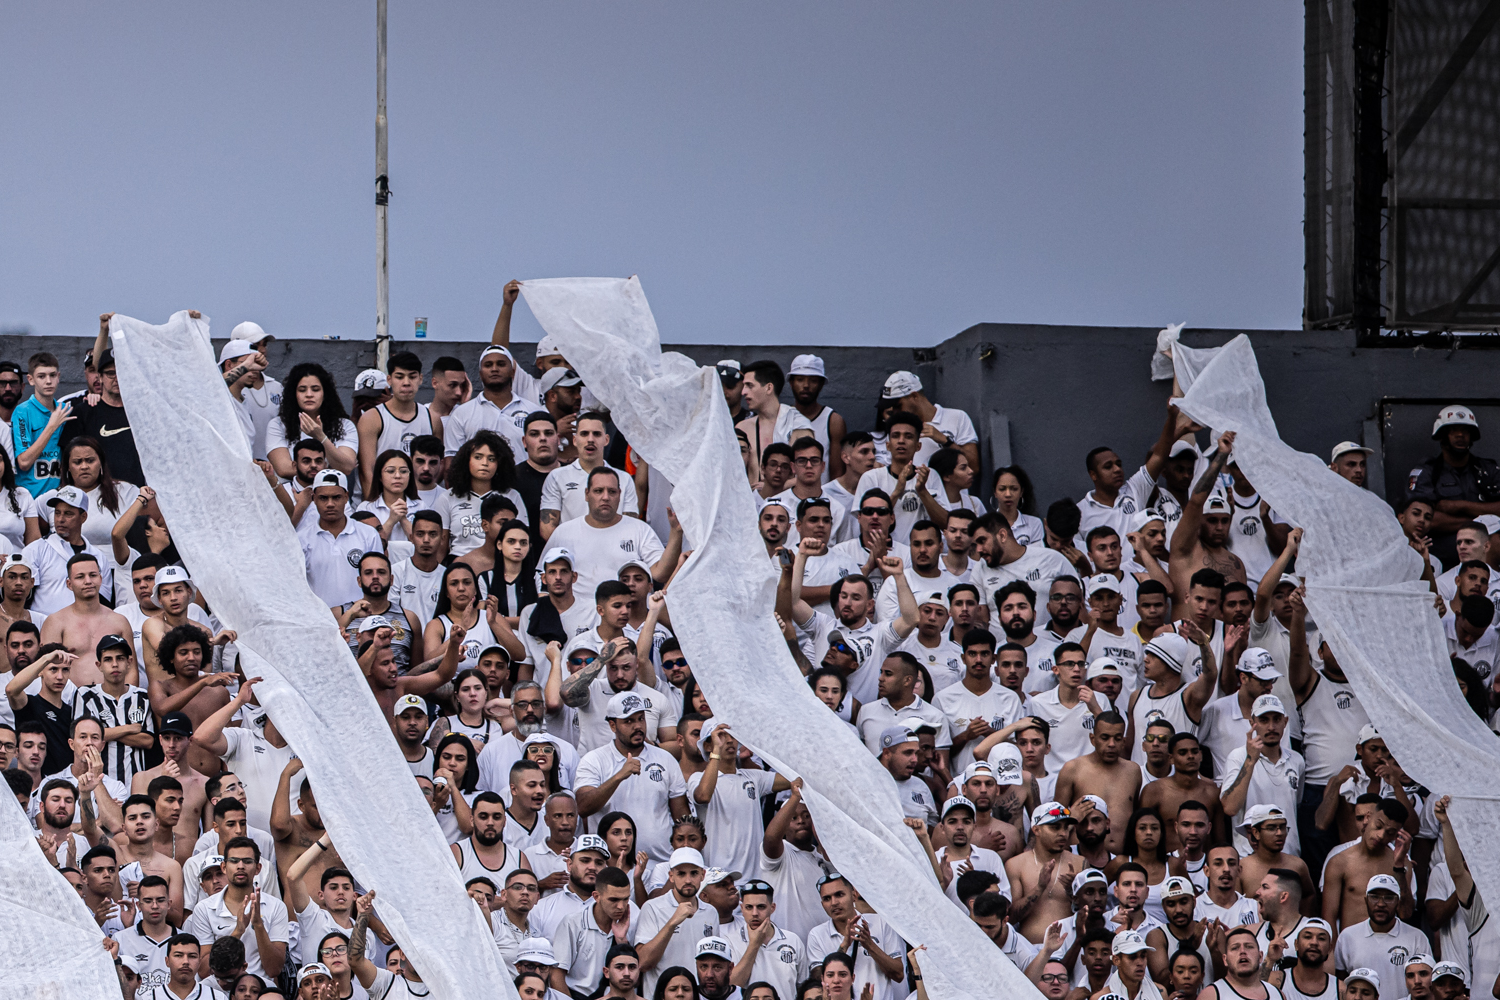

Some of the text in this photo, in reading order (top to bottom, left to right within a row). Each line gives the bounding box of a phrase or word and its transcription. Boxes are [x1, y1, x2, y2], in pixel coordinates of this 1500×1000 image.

[39, 450, 60, 459] ANCO
[1102, 646, 1136, 660] JOVEM
[950, 797, 973, 807] JOVEM
